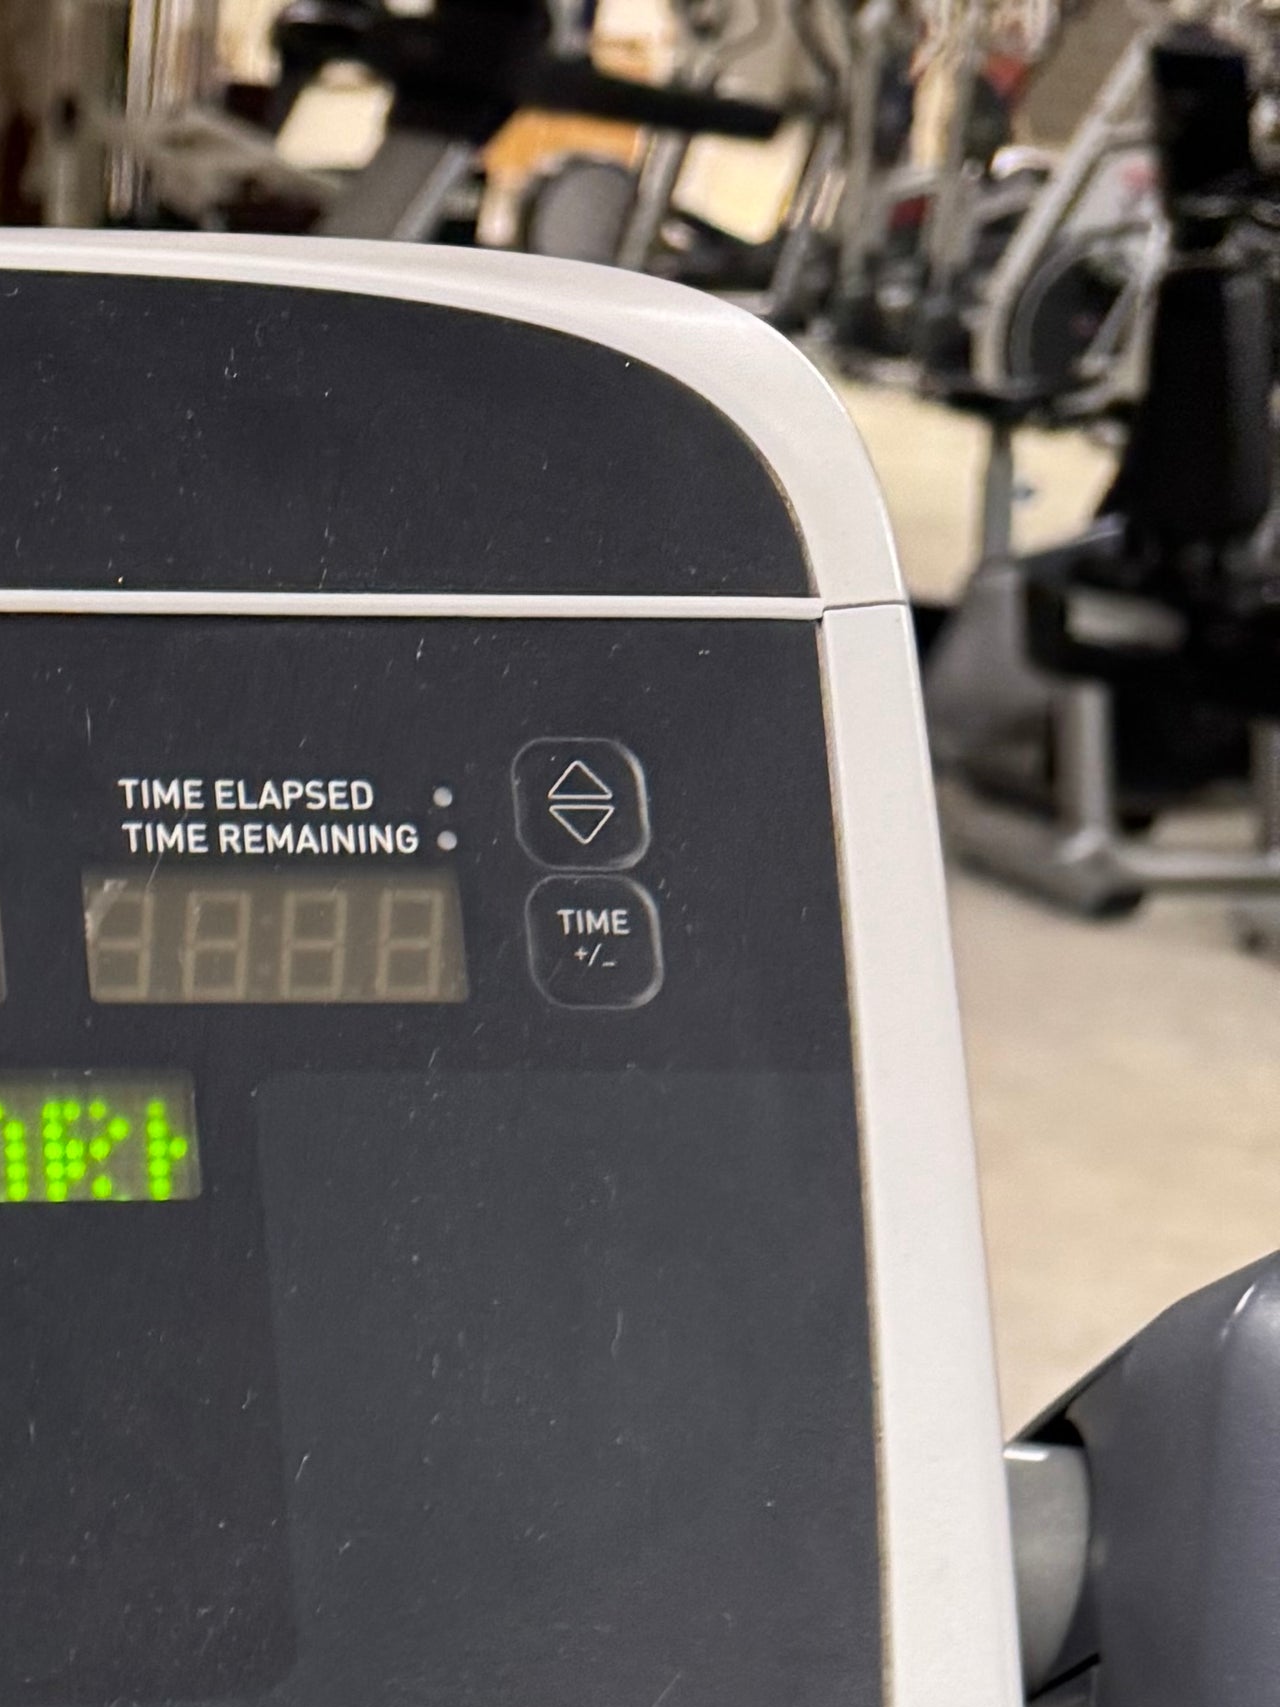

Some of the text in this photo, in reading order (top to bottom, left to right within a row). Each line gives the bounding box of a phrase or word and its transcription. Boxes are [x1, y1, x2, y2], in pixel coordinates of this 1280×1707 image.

[117, 778, 374, 810] TIME ELAPSED
[121, 822, 419, 854] TIME REMAINING
[556, 909, 630, 935] TIME
